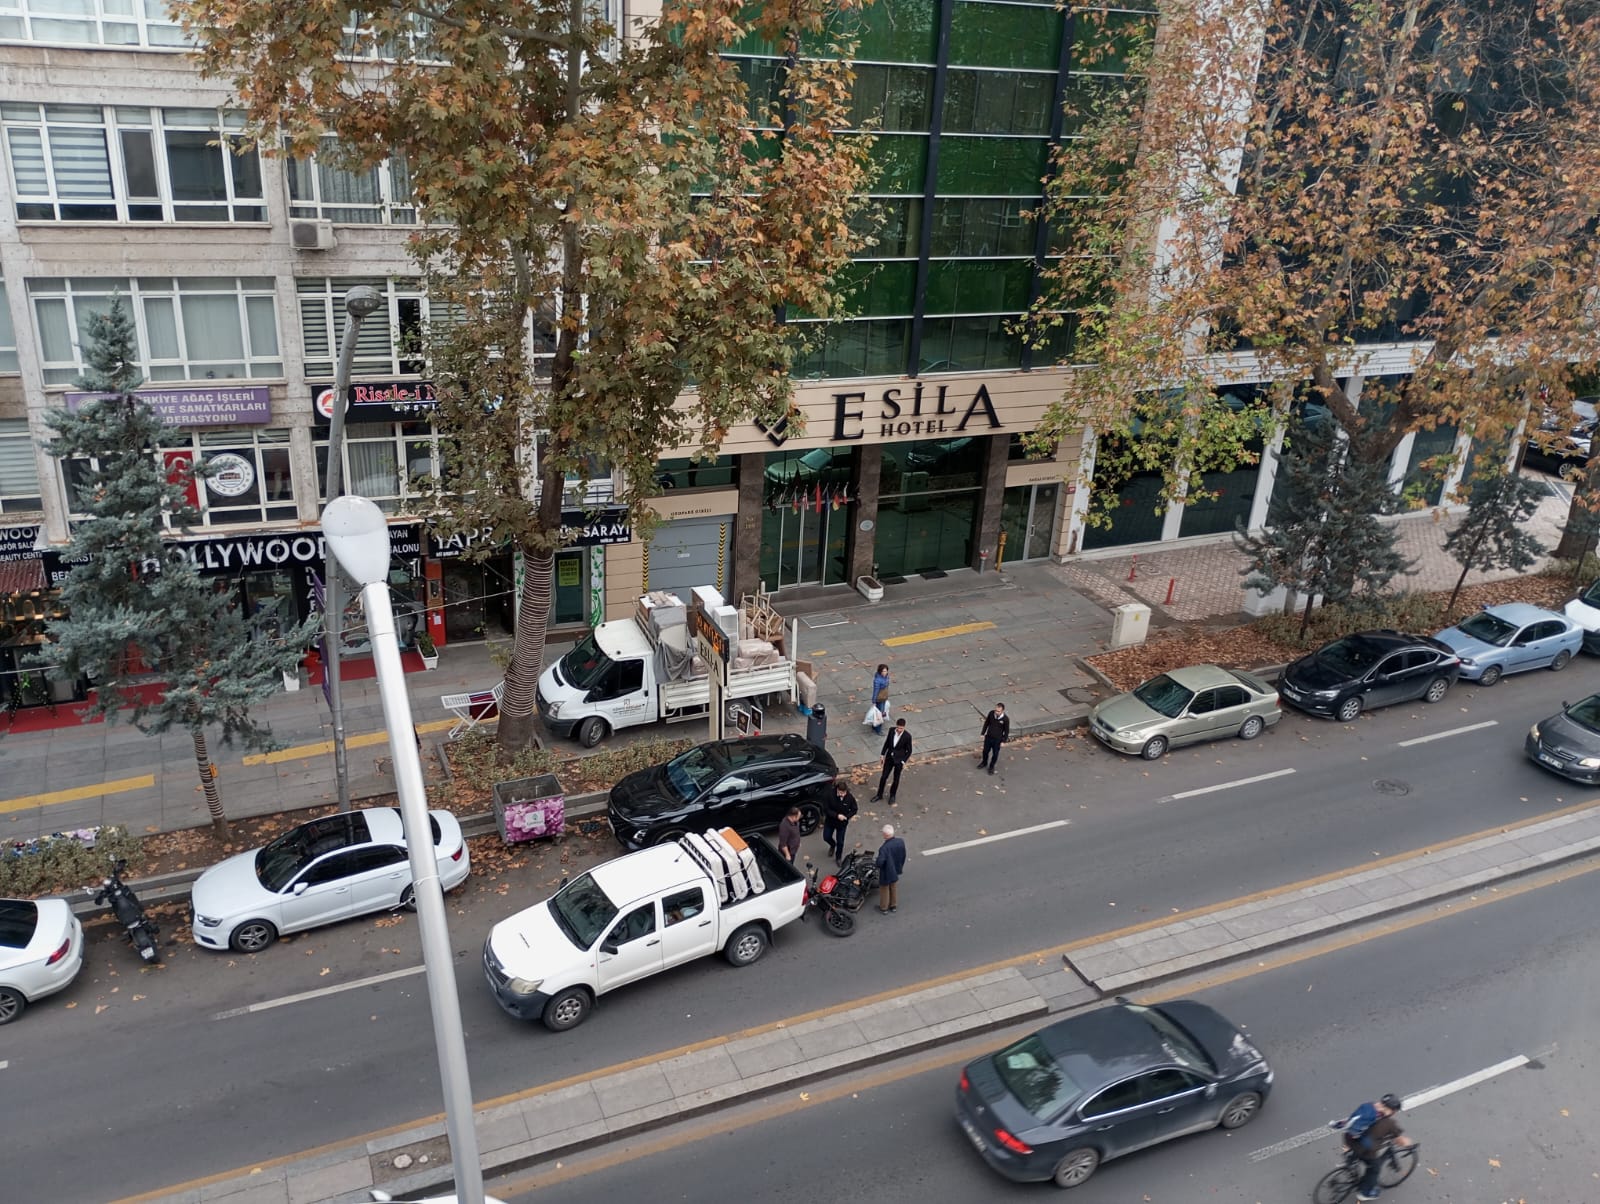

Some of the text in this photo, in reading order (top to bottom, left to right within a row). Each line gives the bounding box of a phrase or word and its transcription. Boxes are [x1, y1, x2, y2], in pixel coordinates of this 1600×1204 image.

[217, 391, 255, 404] İŞLERİ
[354, 384, 421, 402] Risale-i
[160, 404, 176, 414] VE
[179, 402, 267, 413] SANATKARLARI
[829, 382, 1005, 441] ESİLA
[880, 419, 948, 437] HOTEL
[389, 529, 409, 539] AYAN
[583, 523, 629, 538] SARAYI
[390, 543, 420, 554] ALONU
